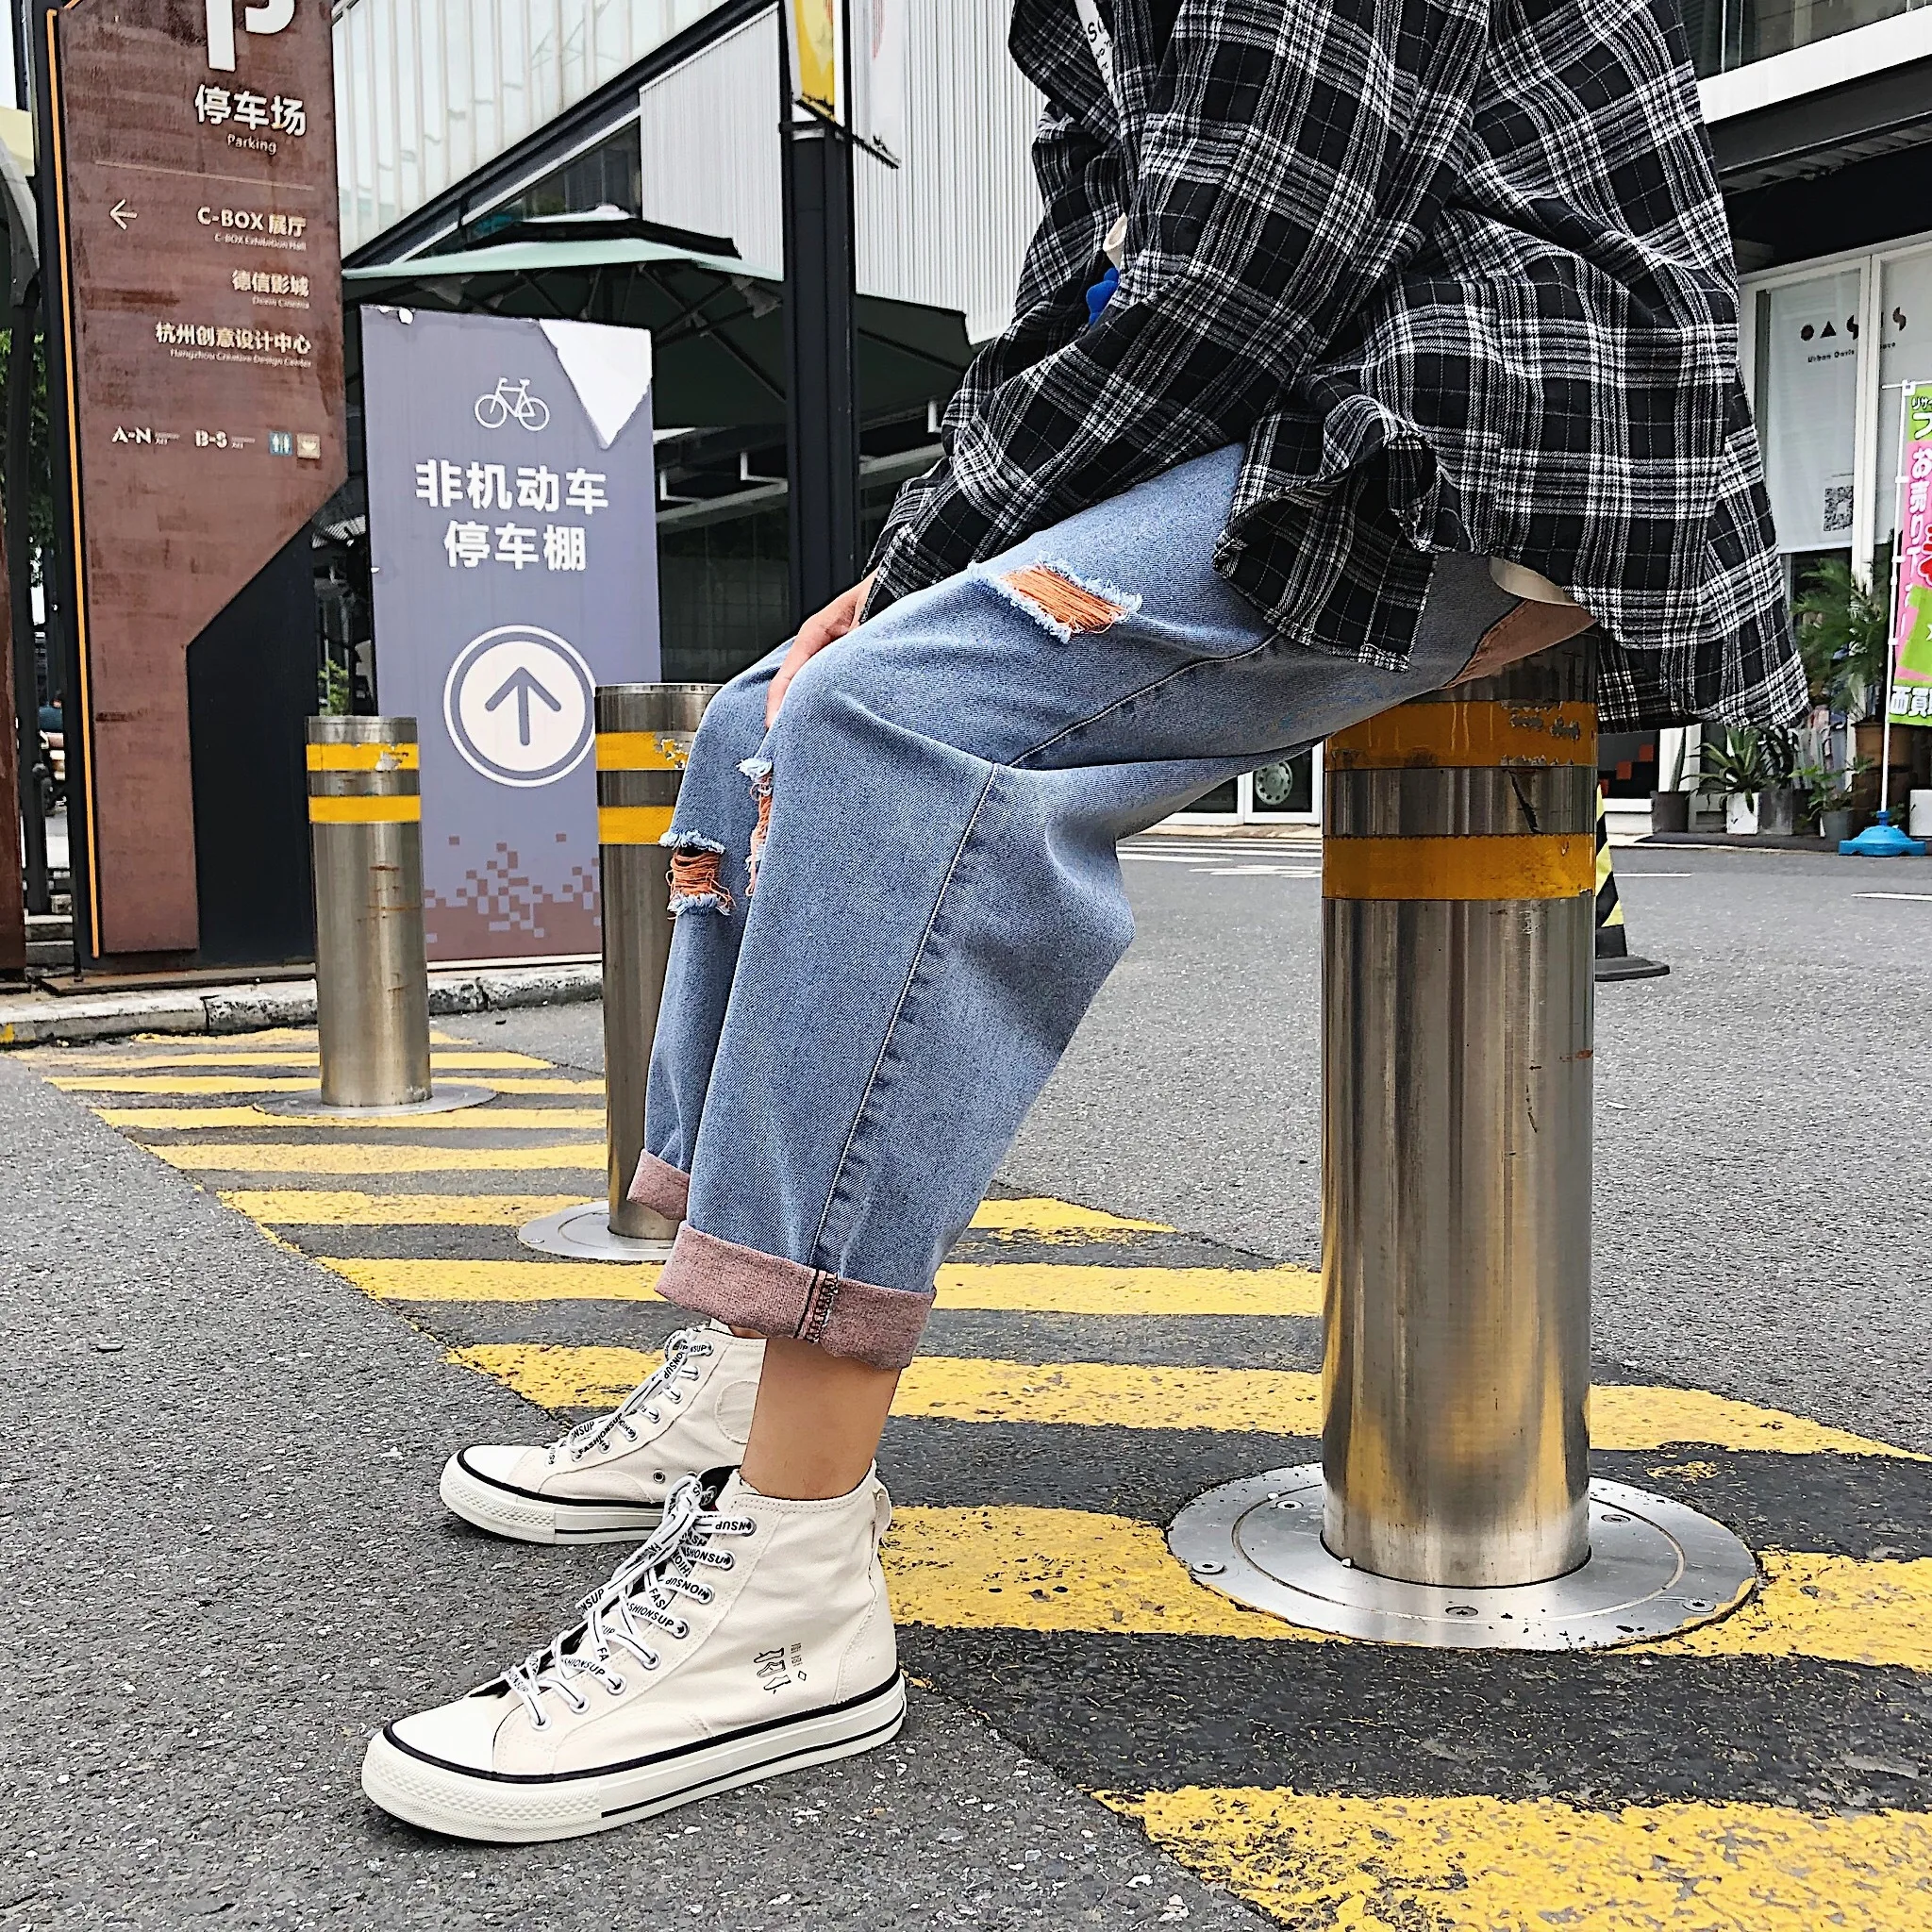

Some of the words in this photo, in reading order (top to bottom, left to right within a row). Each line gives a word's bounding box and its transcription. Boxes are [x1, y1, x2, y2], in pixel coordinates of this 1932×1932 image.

[194, 83, 308, 137] 停车场
[226, 133, 278, 156] Parking
[197, 206, 265, 232] C-BOX
[268, 213, 308, 238] 展厅
[231, 269, 310, 298] 德信影城
[155, 321, 313, 356] 杭州创意设计中心
[111, 425, 153, 444] A-N
[414, 458, 609, 515] 非机动车
[443, 519, 587, 572] 停车棚
